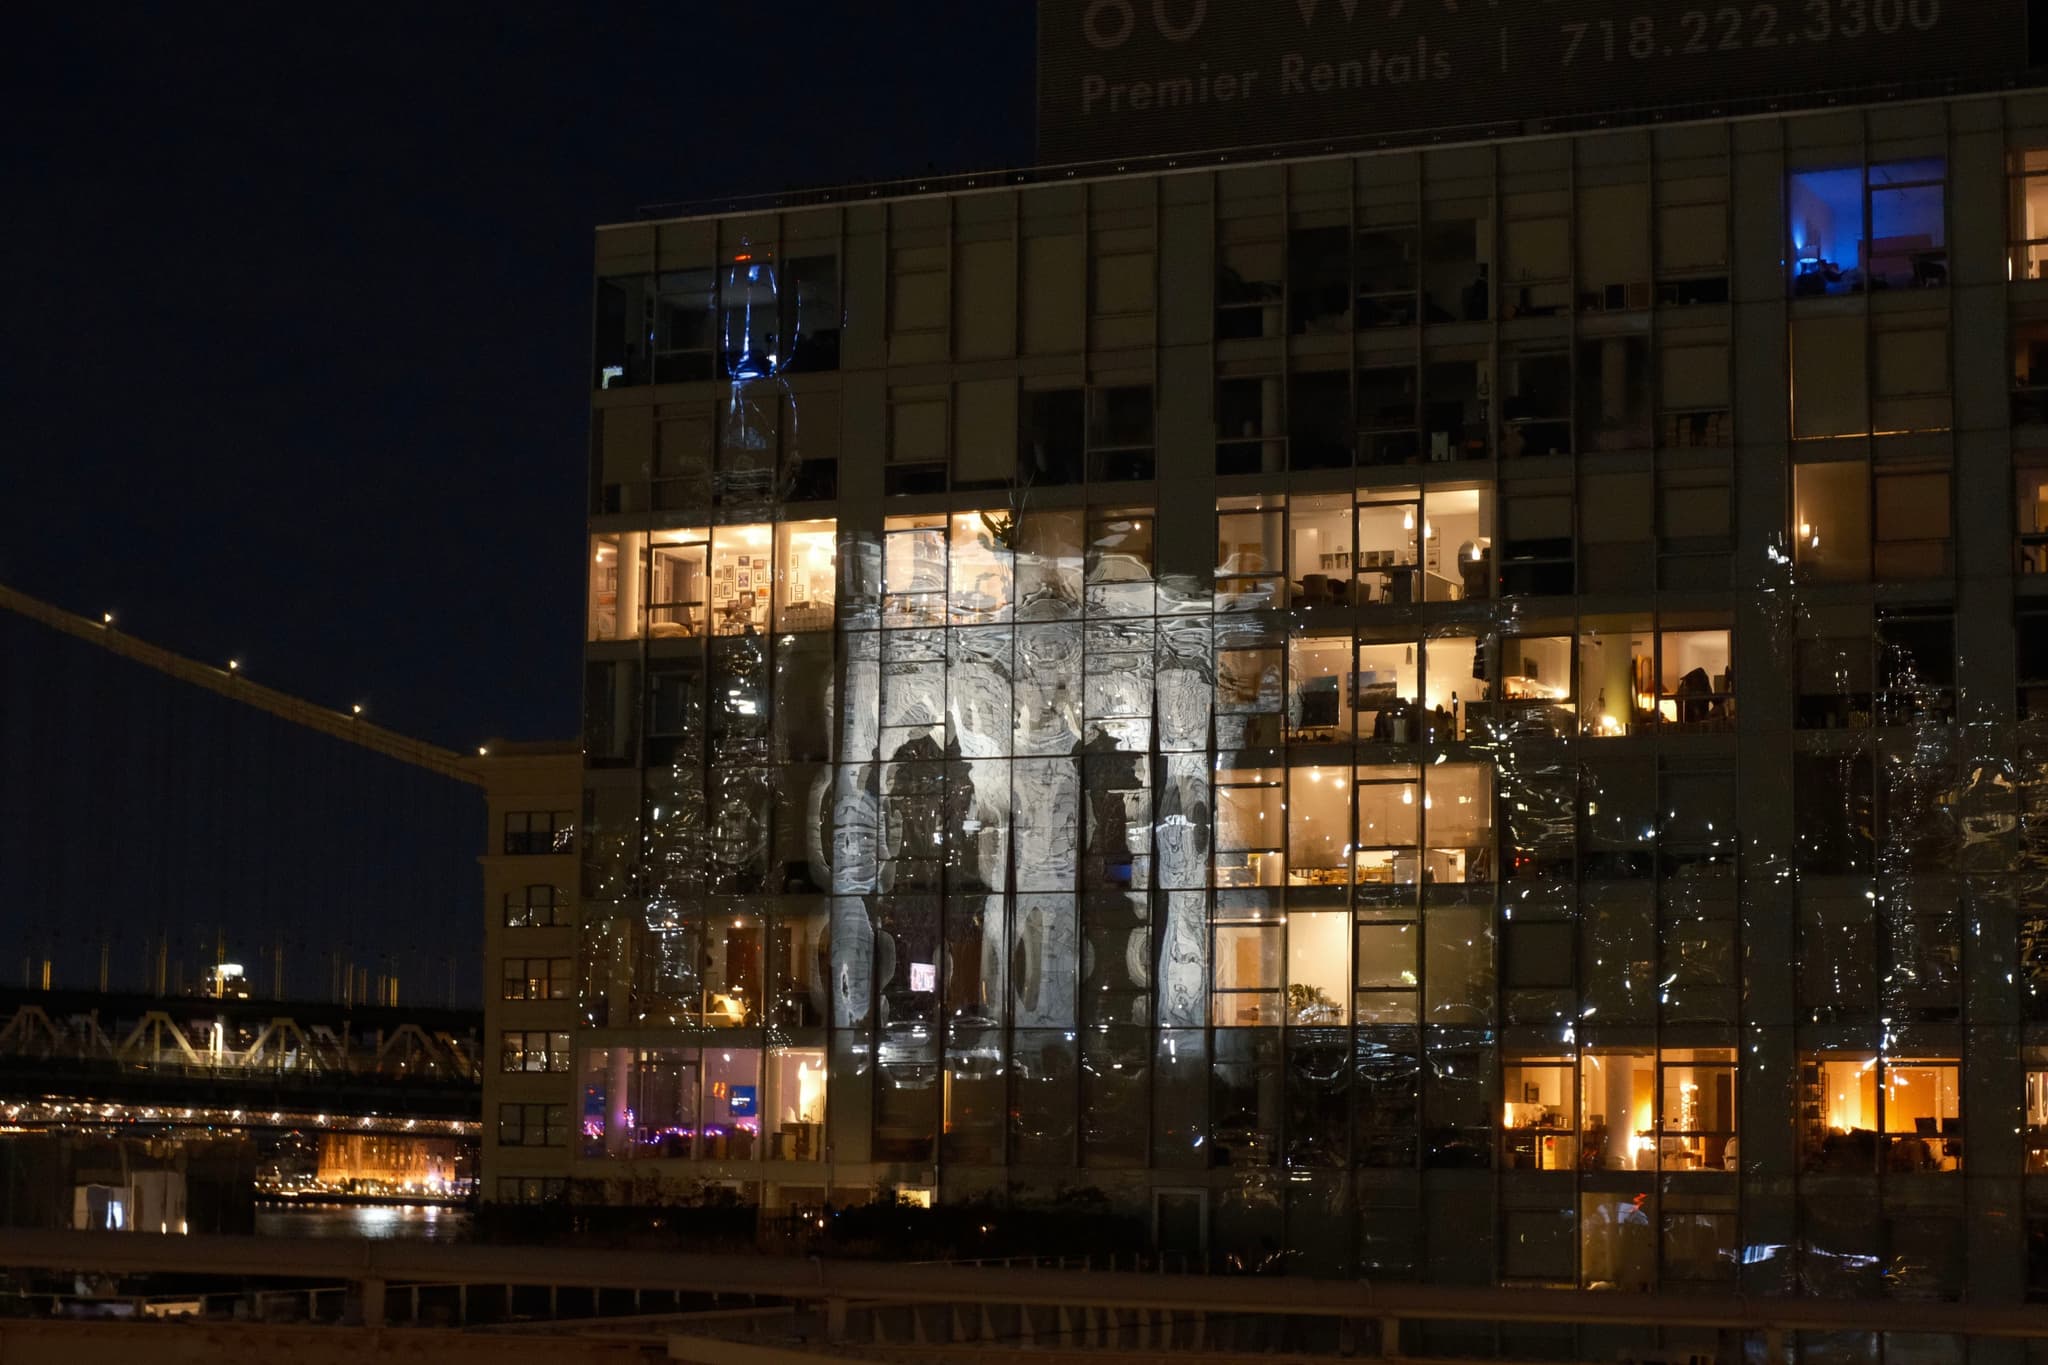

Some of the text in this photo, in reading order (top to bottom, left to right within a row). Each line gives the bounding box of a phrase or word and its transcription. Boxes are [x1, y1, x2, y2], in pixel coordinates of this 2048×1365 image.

[1082, 62, 1259, 115] Premier
[1281, 35, 1451, 94] Rentals
[1561, 0, 1940, 66] 718.222.3300
